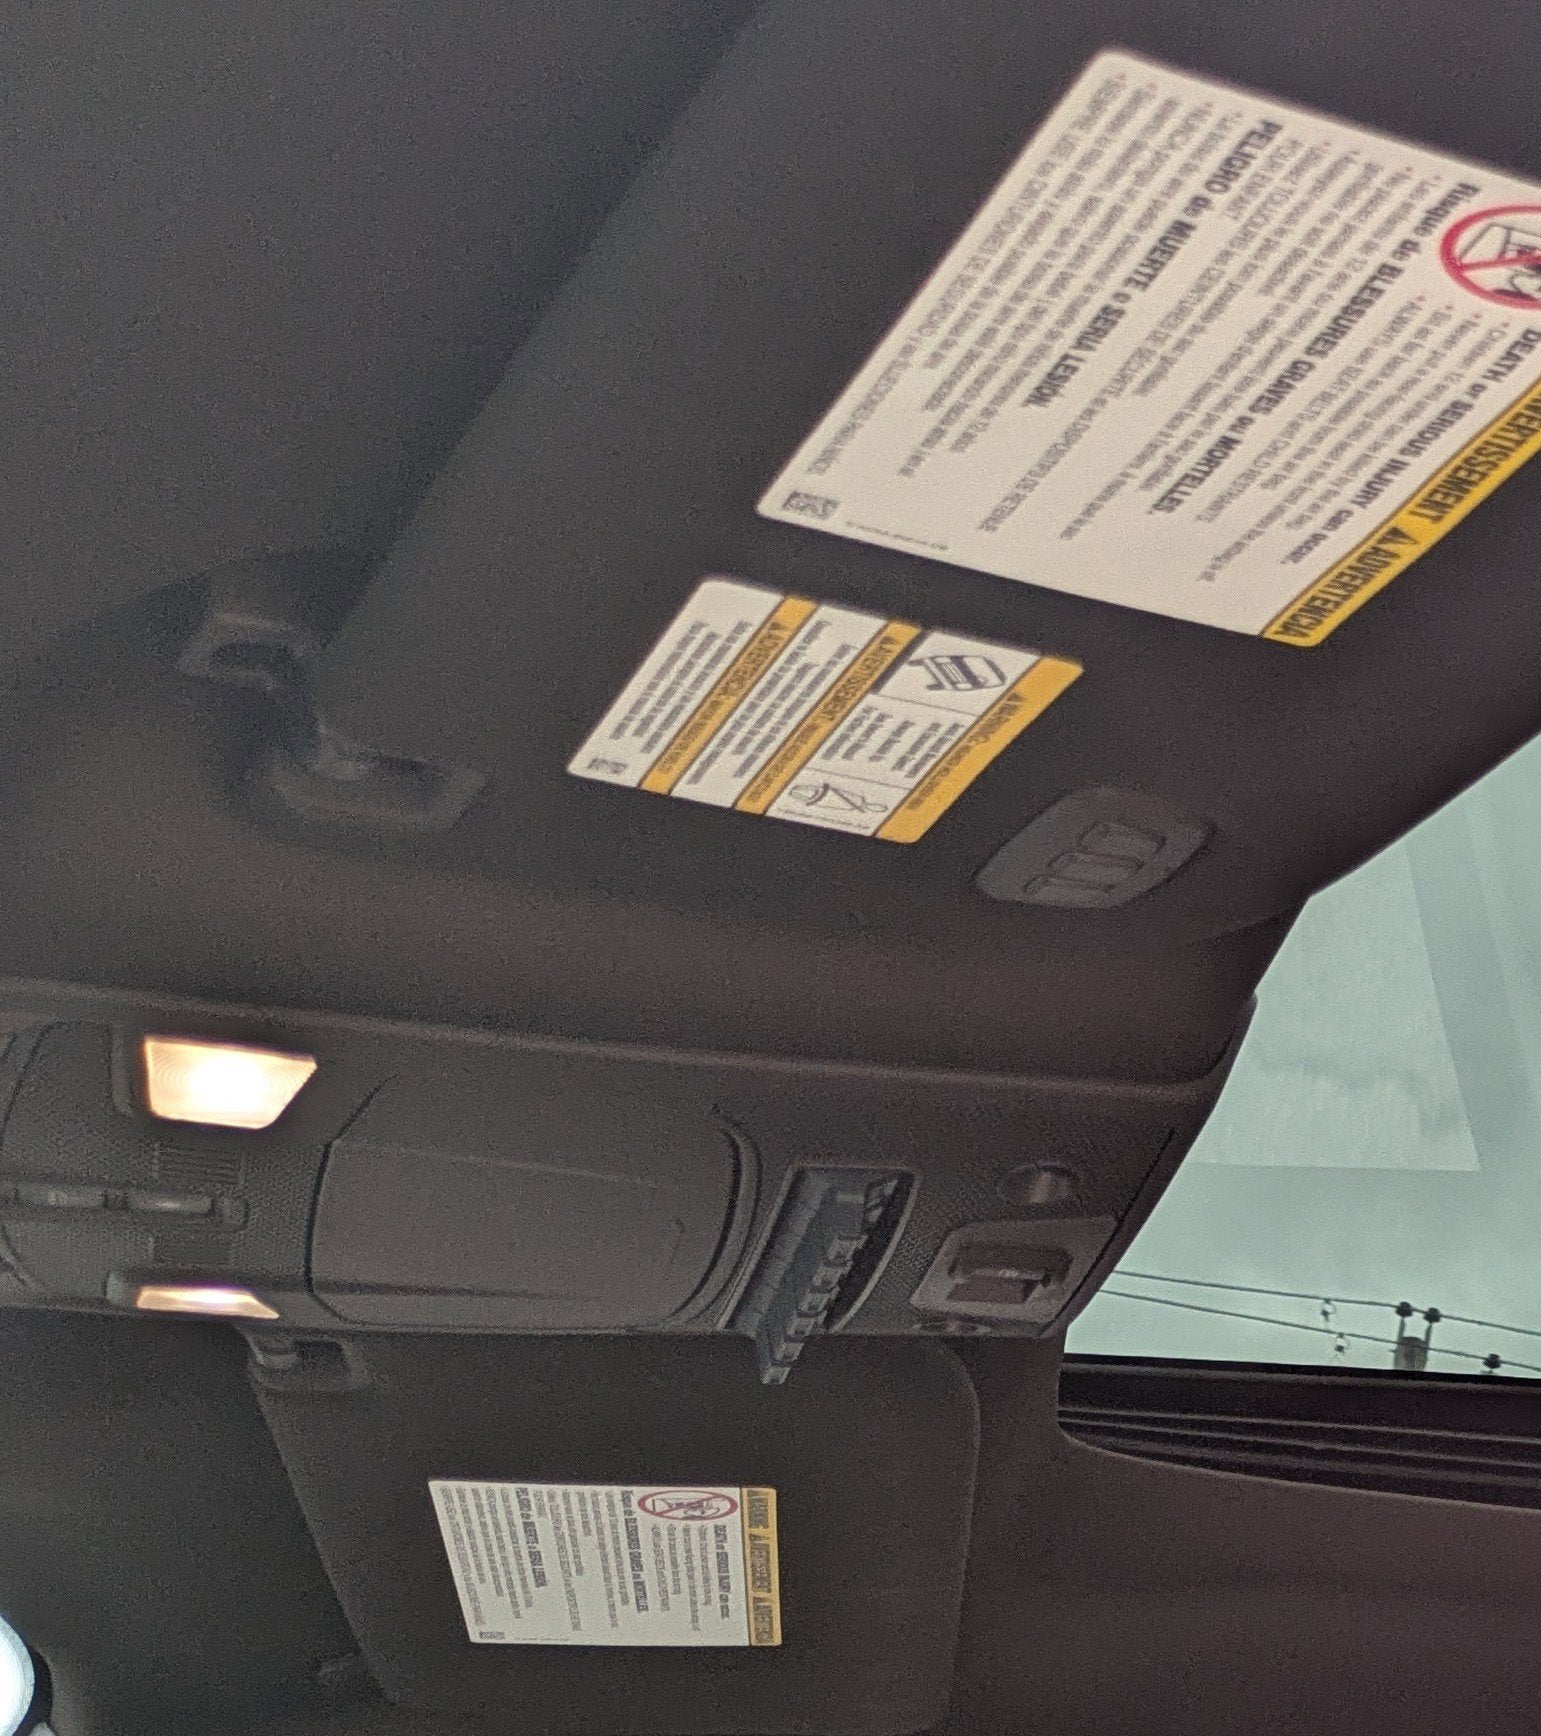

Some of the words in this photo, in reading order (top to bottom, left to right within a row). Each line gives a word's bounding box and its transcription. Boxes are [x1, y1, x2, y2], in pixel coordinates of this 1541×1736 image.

[1199, 117, 1285, 197] PELIGRO
[1179, 193, 1219, 220] de
[1407, 180, 1482, 240] Risque
[1119, 219, 1200, 292] MUERTE
[1387, 238, 1429, 264] de
[1067, 304, 1128, 354] SERIA
[1298, 262, 1408, 359] BLESSURES
[1244, 356, 1319, 417] GRAVES
[1225, 414, 1259, 435] ou
[1395, 398, 1475, 460] SERIOUS
[1143, 433, 1245, 520] MORTELLES.
[1342, 457, 1412, 509] INJURY
[1271, 544, 1402, 642] ADVERTENCIA
